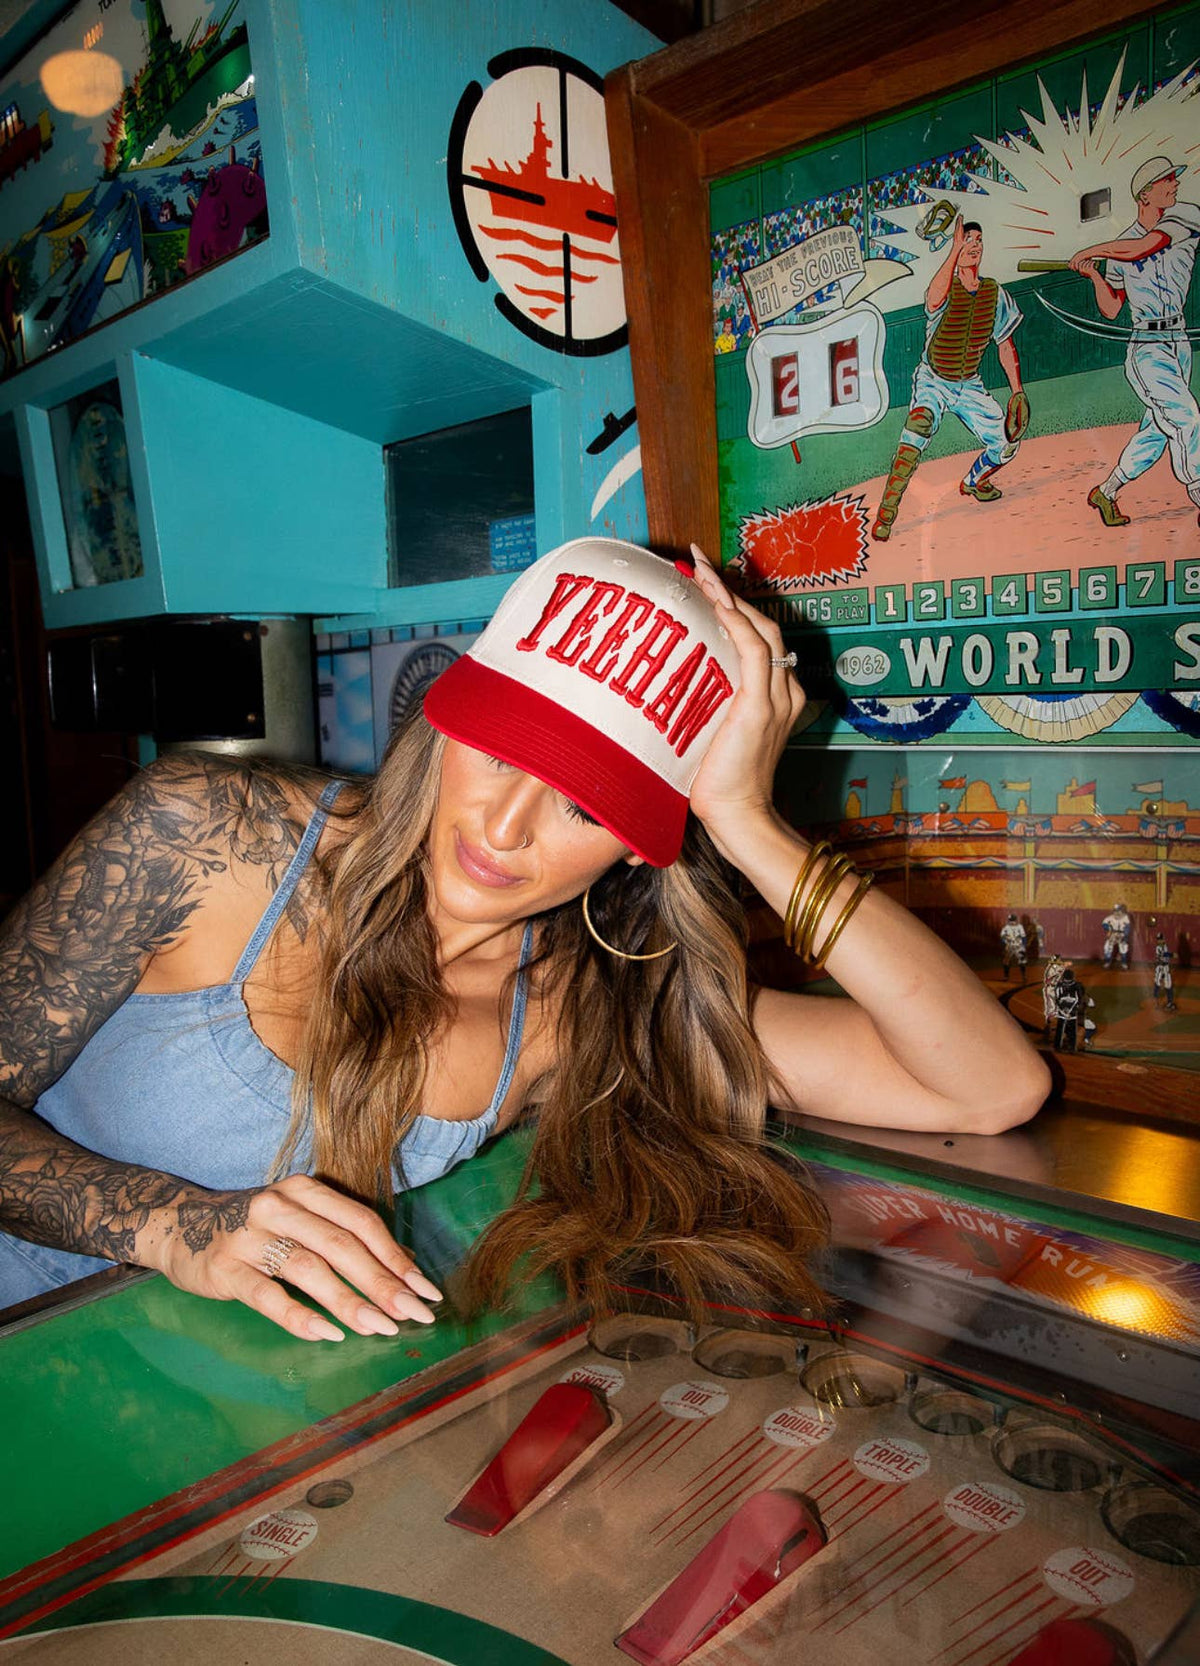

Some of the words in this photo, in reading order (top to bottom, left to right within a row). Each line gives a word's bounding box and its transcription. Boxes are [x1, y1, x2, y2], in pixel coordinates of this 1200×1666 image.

[777, 252, 799, 273] THE
[801, 230, 854, 259] PREVIOUS
[780, 361, 799, 408] 2
[836, 356, 859, 404] 6
[842, 595, 859, 604] TO
[884, 590, 898, 617] 1
[919, 588, 938, 614] 2
[959, 584, 978, 610] 3
[1000, 580, 1019, 608] 4
[1042, 577, 1063, 605] 5
[1086, 573, 1108, 601] 6
[1133, 569, 1156, 599] 7
[1183, 565, 1200, 595] 8
[755, 596, 832, 622] NINGS
[837, 606, 866, 620] PLAY
[516, 572, 734, 758] YEEHAW
[841, 654, 886, 677] 1962
[899, 624, 1133, 688] WORLD
[935, 1204, 1022, 1248] HOME
[680, 1390, 713, 1406] OUT
[772, 1412, 831, 1440] DOUBLE
[865, 1443, 921, 1475] TRIPLE
[953, 1487, 1019, 1525] DOUBLE
[250, 1520, 310, 1547] SINGLE
[1069, 1559, 1111, 1586] OUT
